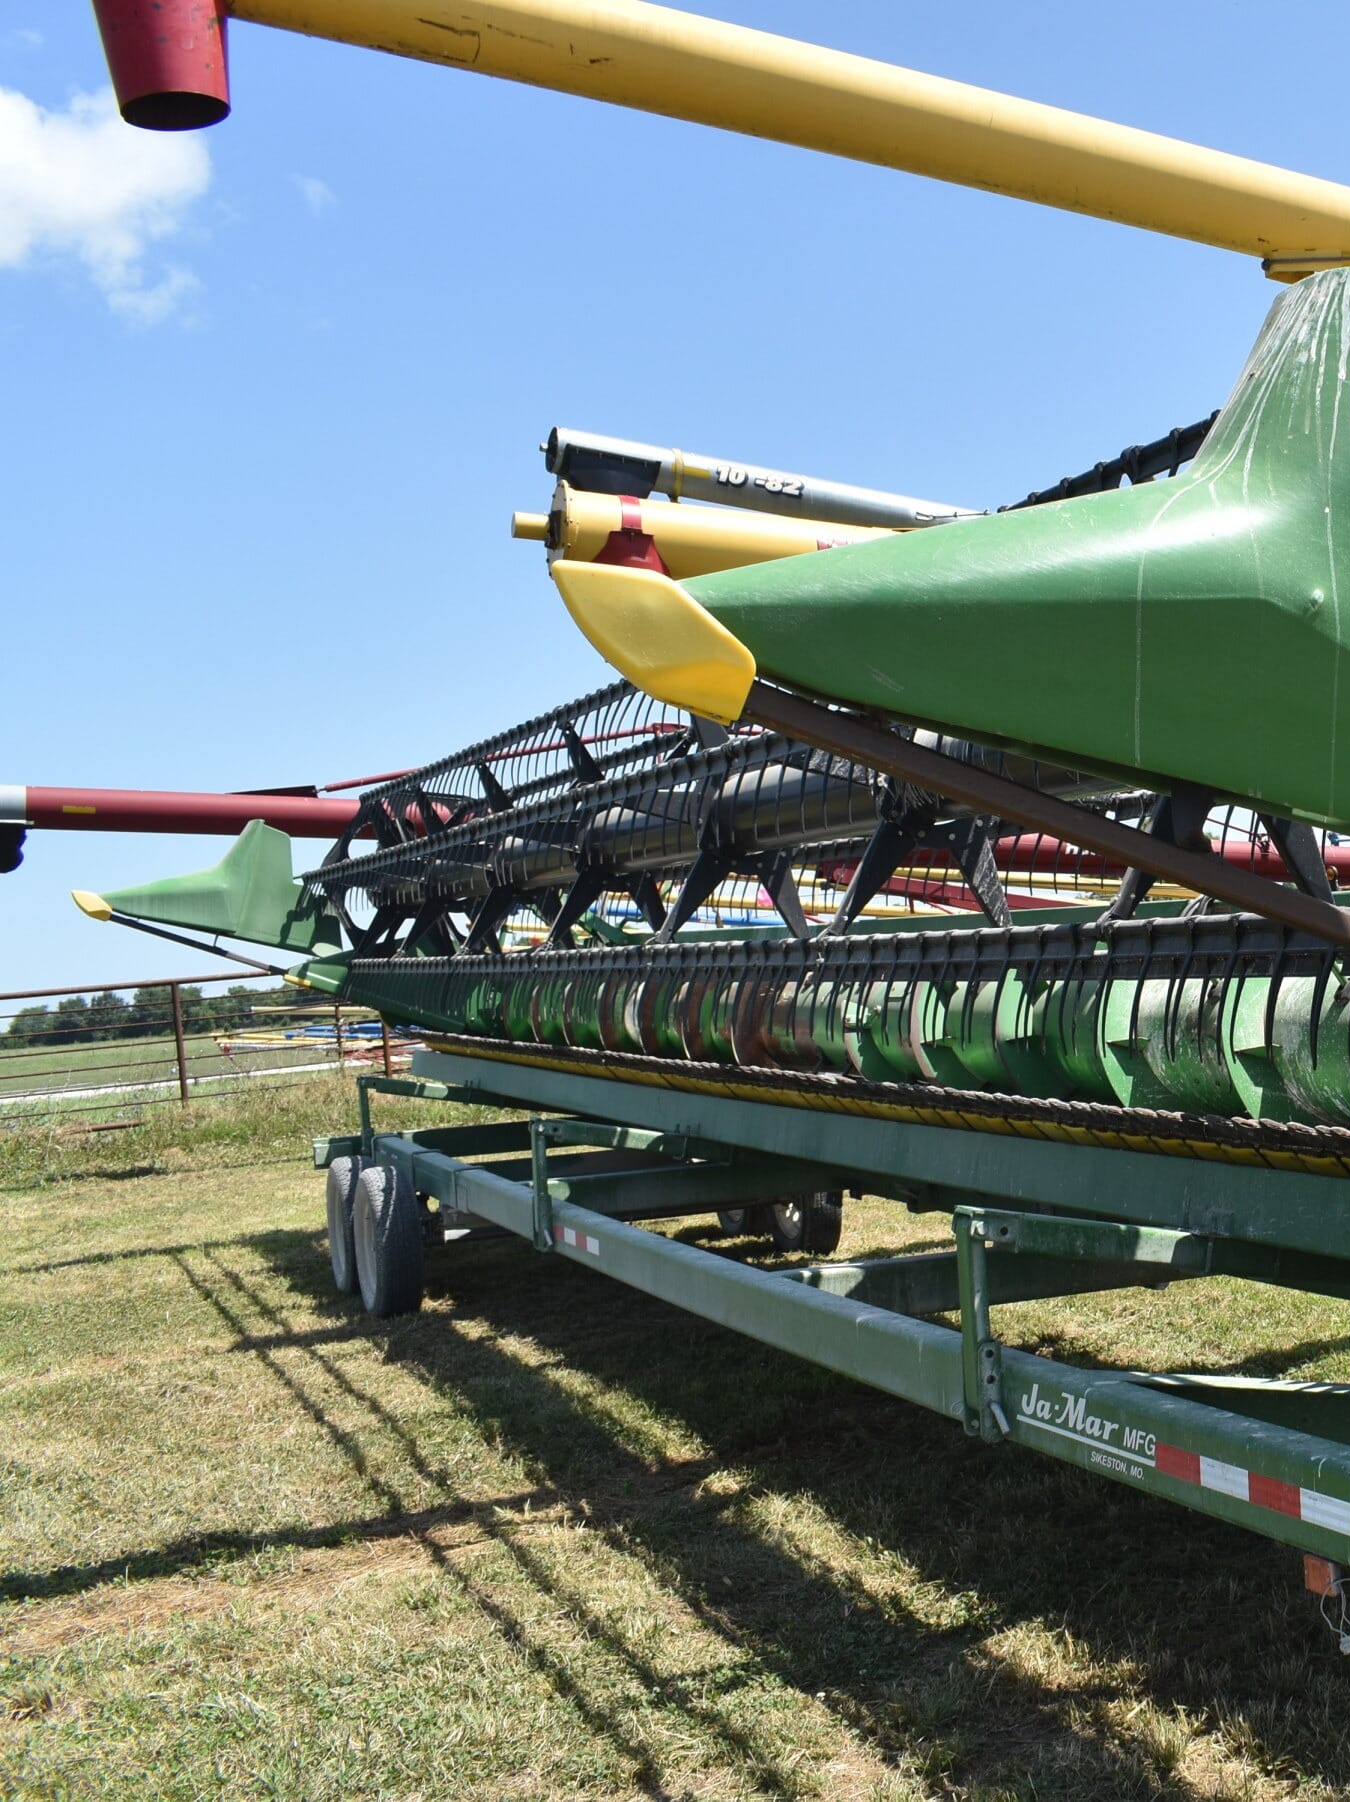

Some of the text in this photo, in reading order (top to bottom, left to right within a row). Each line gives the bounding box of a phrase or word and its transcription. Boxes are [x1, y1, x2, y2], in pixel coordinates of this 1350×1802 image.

[1122, 1426, 1156, 1457] MFG
[1090, 1451, 1145, 1481] SIKESTON, MO.
